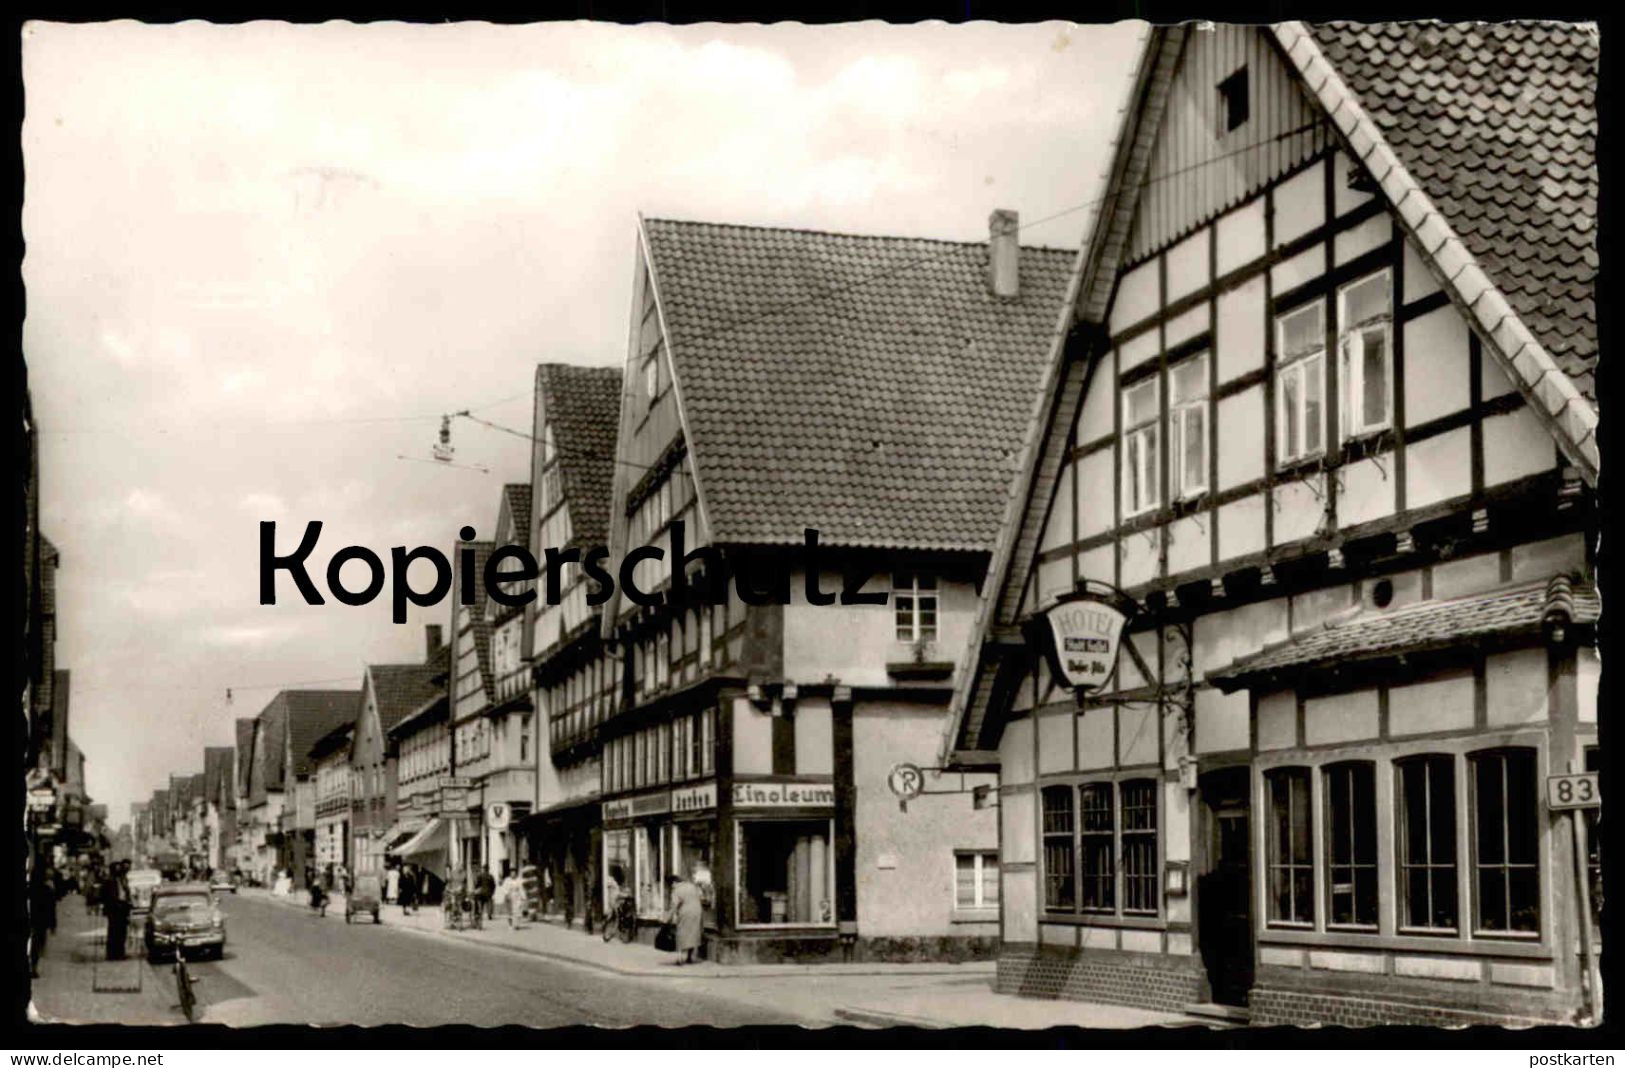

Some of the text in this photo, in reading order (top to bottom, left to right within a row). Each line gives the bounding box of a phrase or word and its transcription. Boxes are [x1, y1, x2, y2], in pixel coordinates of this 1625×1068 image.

[1056, 609, 1114, 637] HOTEL
[734, 784, 833, 803] Linoleum
[1558, 778, 1593, 803] 83
